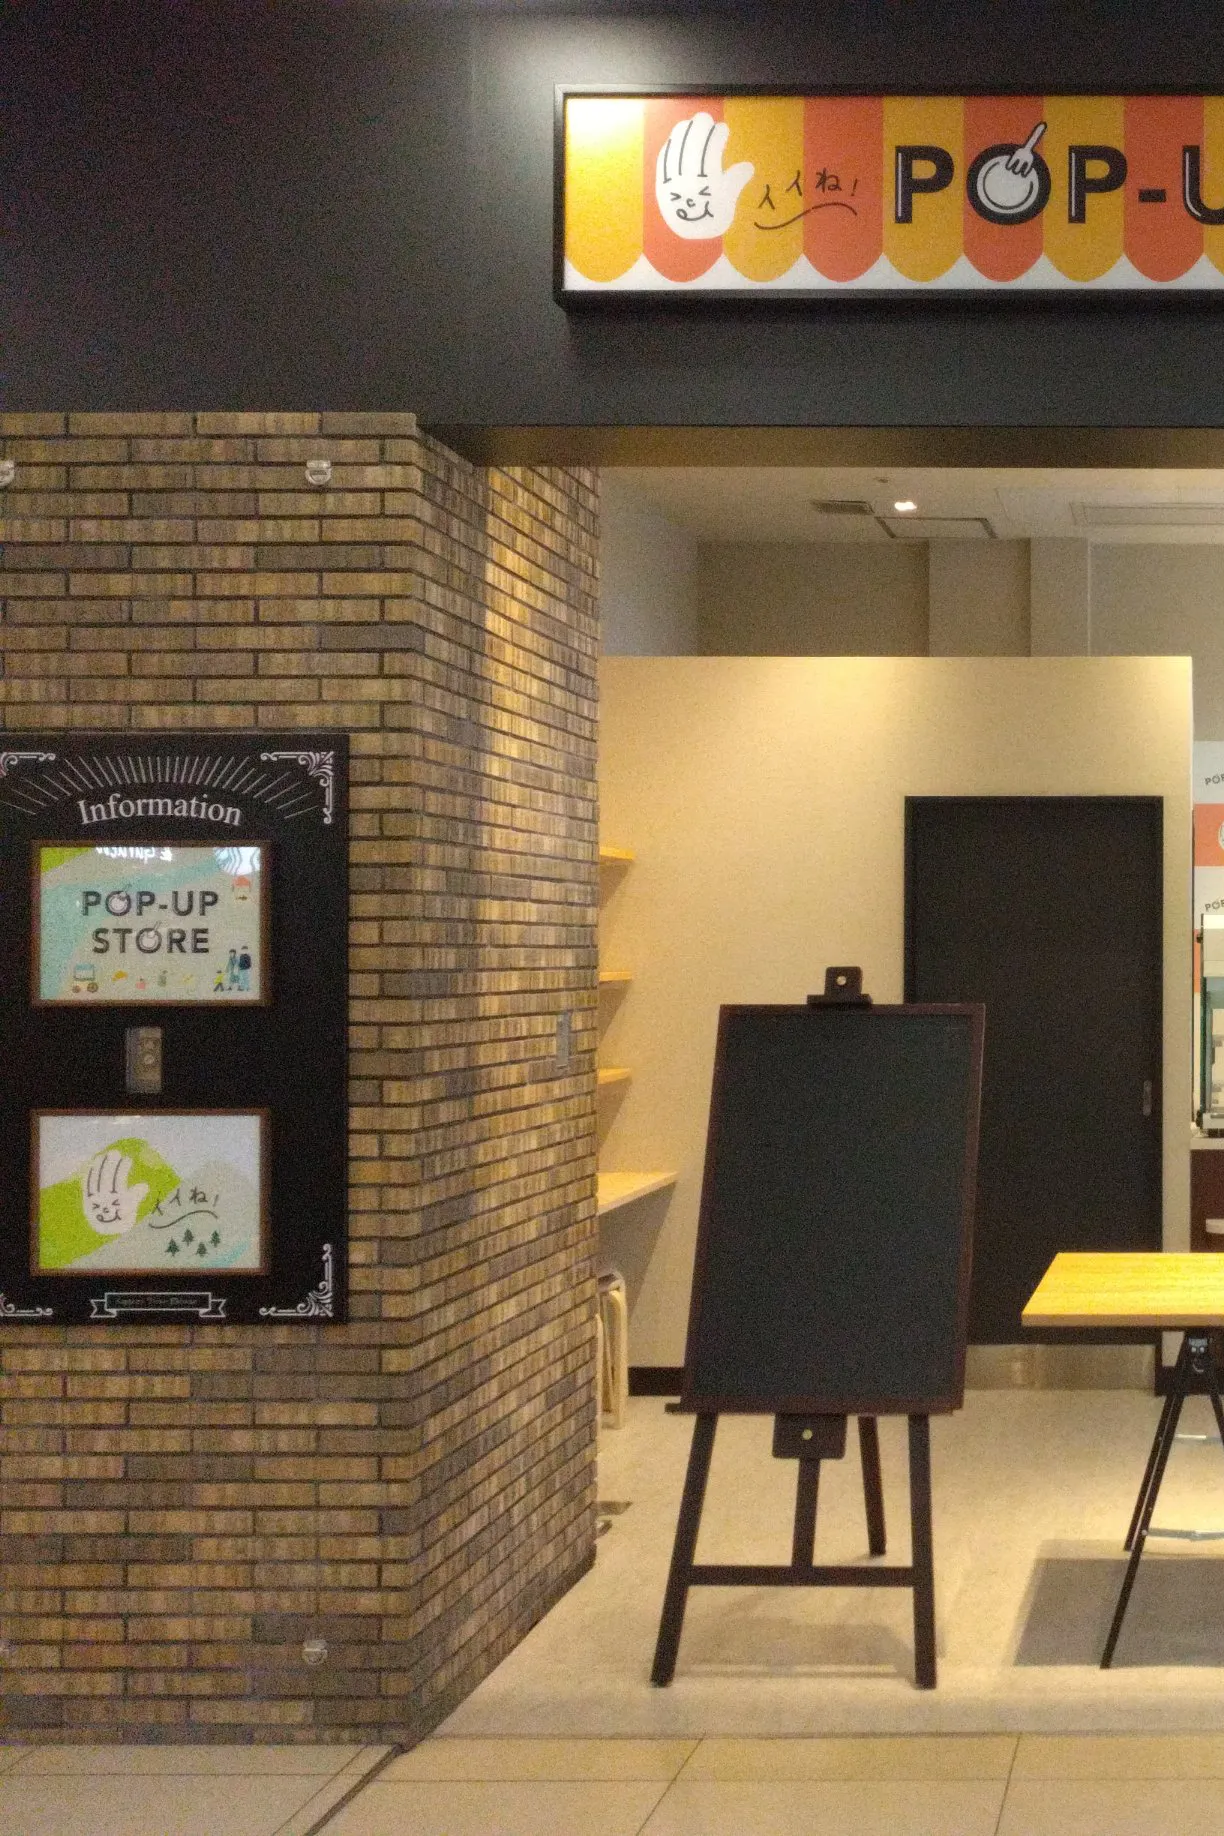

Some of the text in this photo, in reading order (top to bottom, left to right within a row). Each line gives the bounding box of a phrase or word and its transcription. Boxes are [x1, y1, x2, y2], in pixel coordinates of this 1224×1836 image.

[78, 793, 243, 827] Information
[81, 890, 219, 917] POP-UP
[92, 927, 210, 954] STORE
